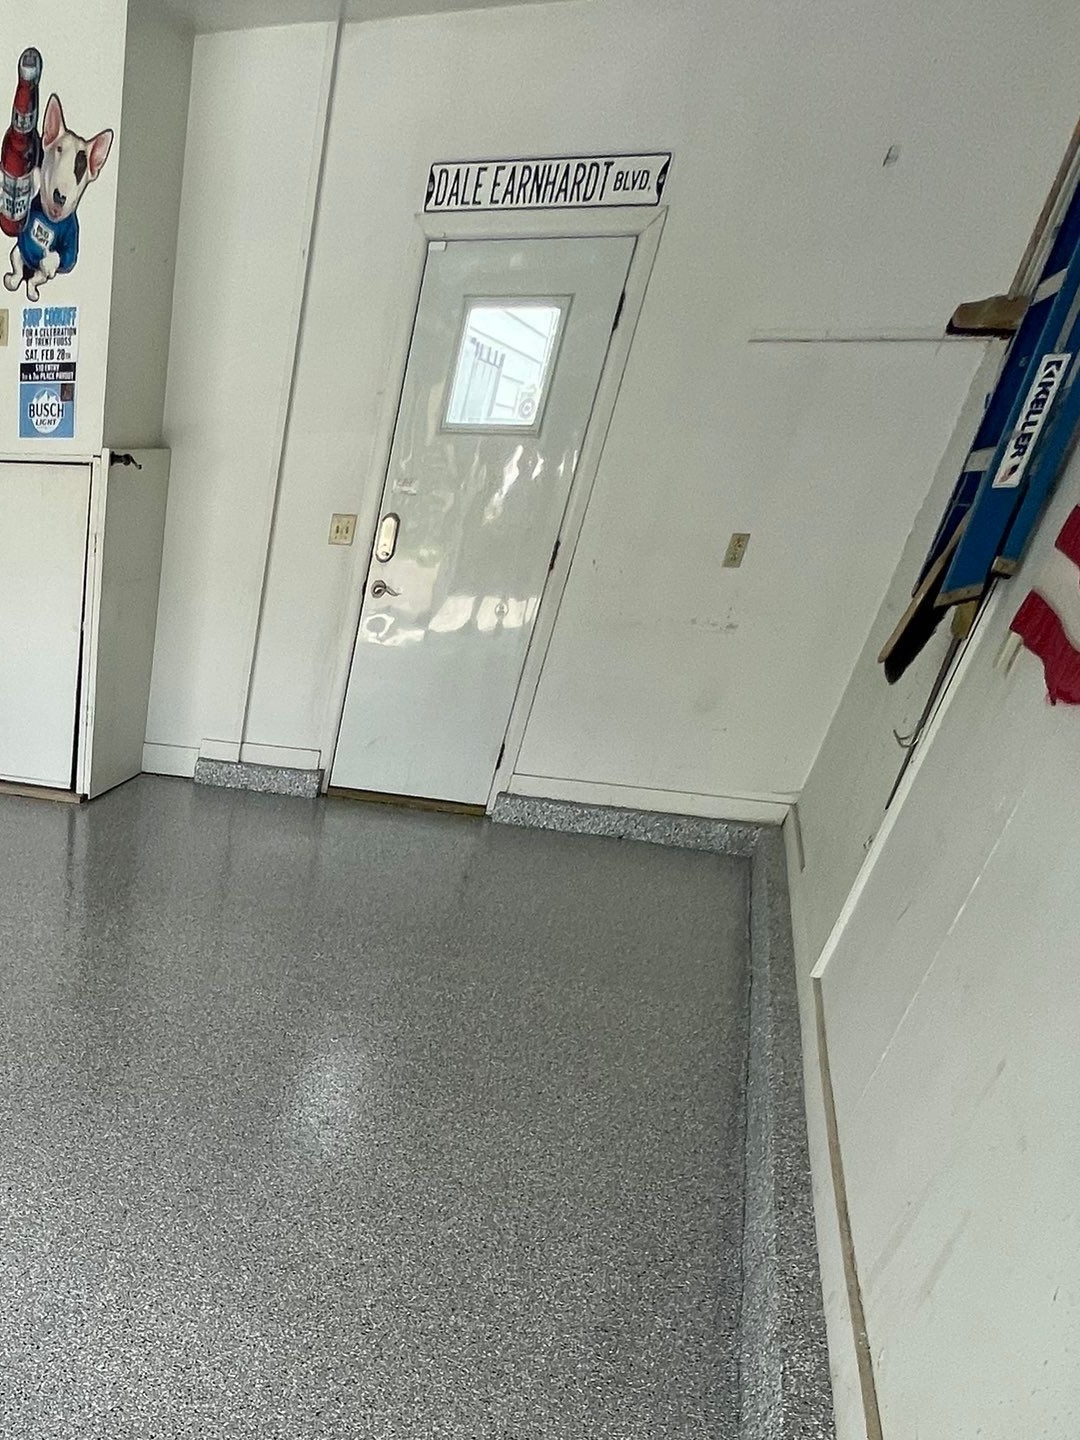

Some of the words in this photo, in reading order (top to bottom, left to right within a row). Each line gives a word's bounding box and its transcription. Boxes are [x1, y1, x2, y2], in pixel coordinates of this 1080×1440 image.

[434, 166, 488, 206] DALE
[489, 161, 615, 204] EARNHARDT
[612, 170, 651, 191] BLVD.
[41, 349, 54, 361] FEB
[28, 403, 65, 419] BUSCH
[35, 418, 57, 427] LIGHT
